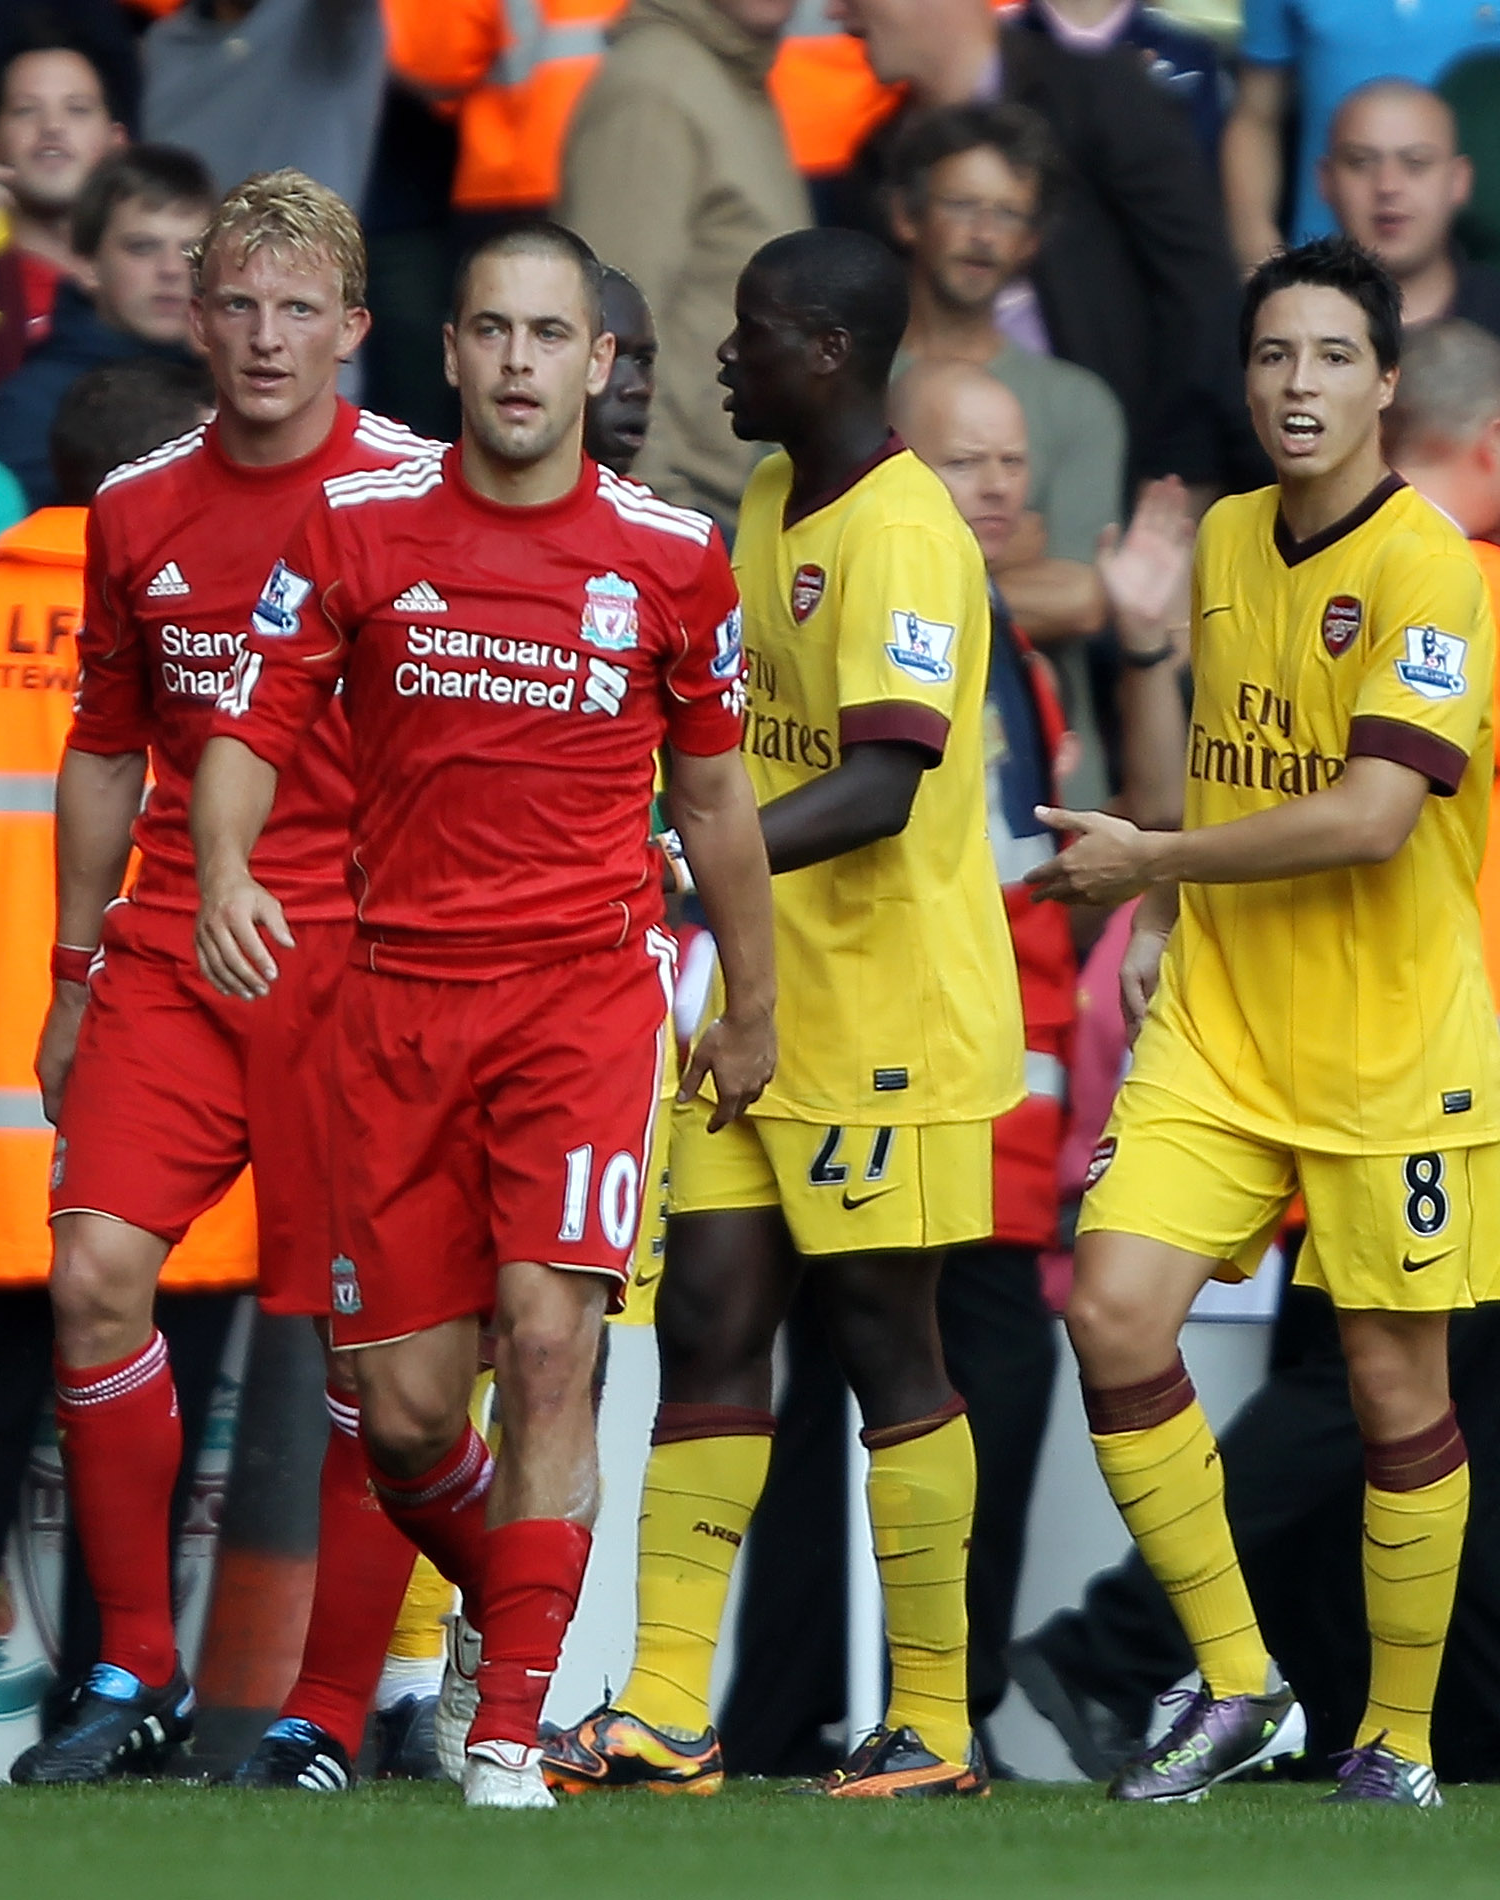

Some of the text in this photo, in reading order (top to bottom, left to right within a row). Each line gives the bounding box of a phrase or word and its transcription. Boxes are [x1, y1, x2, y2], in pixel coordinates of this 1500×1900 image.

[8, 605, 77, 654] LF
[407, 624, 578, 671] Standard
[161, 662, 235, 695] Char
[394, 661, 576, 712] Chartered
[740, 697, 832, 770] irates
[1238, 682, 1292, 738] Fly
[1190, 723, 1348, 796] Emirate
[558, 1143, 639, 1250] 10
[1402, 1151, 1449, 1238] 8
